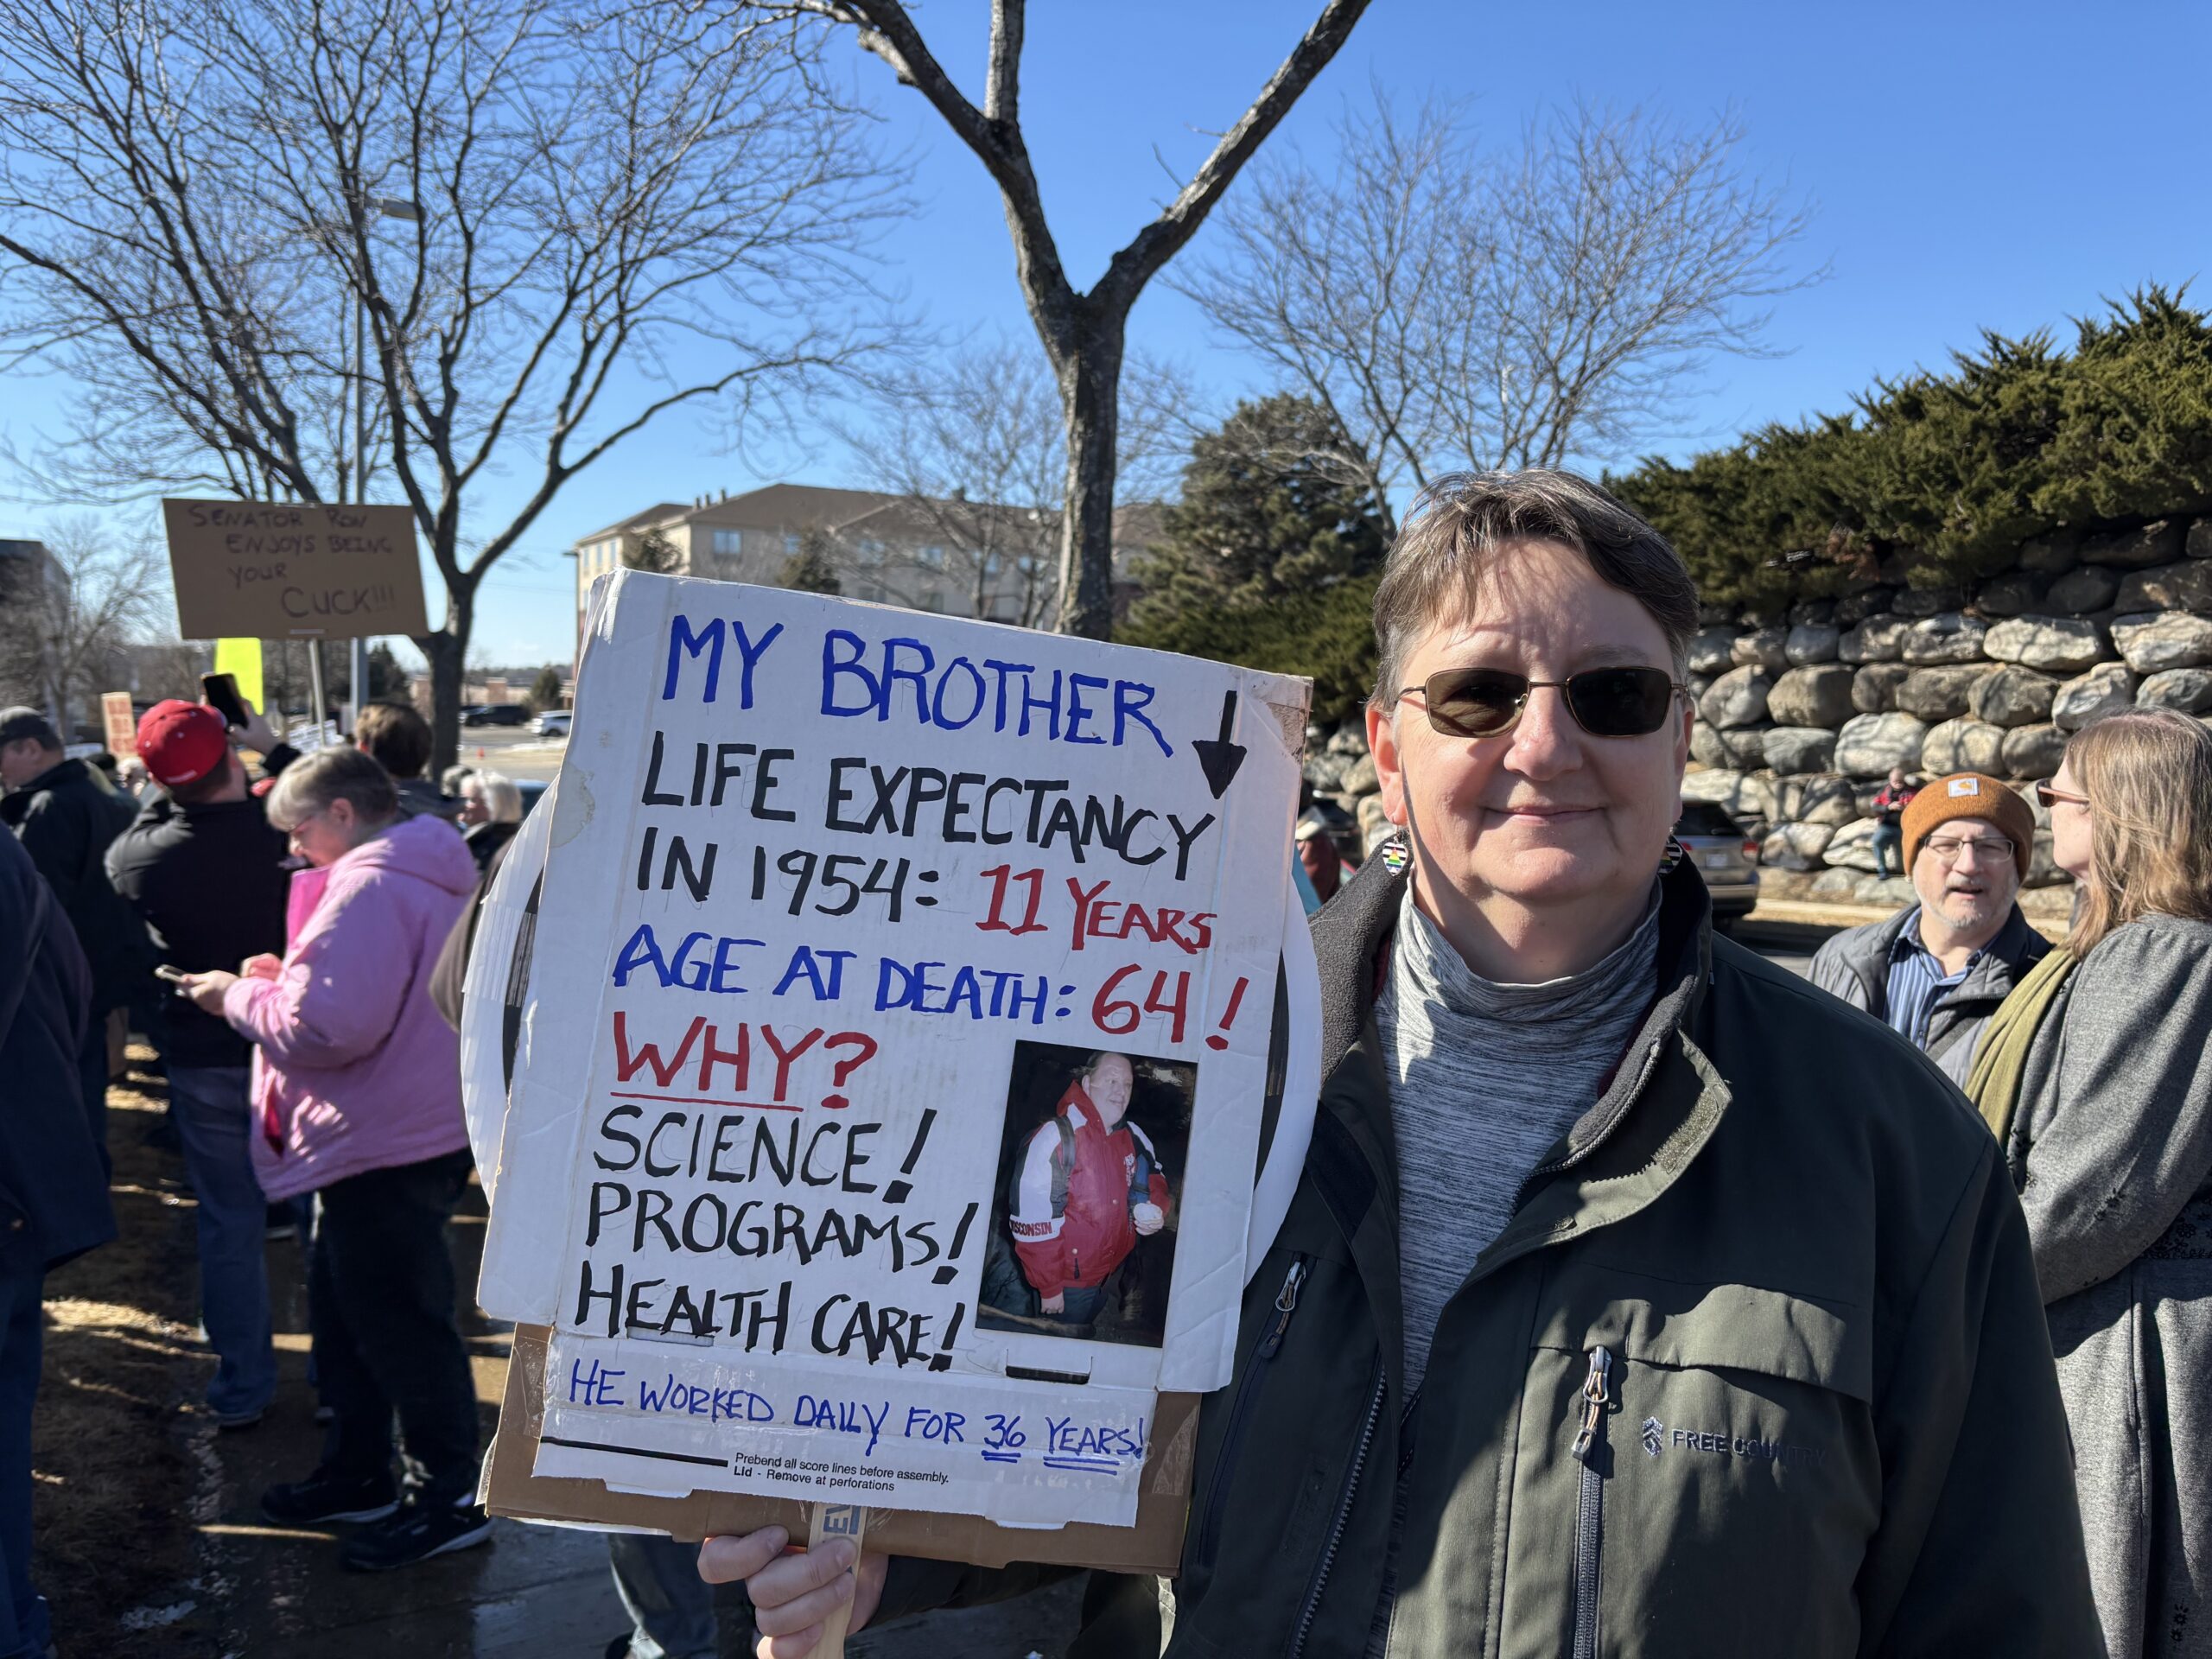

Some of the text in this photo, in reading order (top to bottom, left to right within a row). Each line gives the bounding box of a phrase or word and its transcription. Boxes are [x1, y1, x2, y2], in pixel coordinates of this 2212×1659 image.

[188, 504, 302, 528] SENATOR
[226, 533, 393, 556] ENJOYS BEING
[227, 563, 288, 589] YOUR
[280, 583, 396, 619] CUCK!!!
[662, 614, 1173, 758] MY BROTHER
[642, 731, 1215, 880] LIFE EXPECTANCY
[637, 827, 1217, 954] IN 1954: 11 YEARS
[613, 925, 766, 994] AGE
[772, 945, 856, 1000] AT
[874, 957, 1075, 1024] DEATH:
[613, 1011, 877, 1109] WHY?
[593, 1104, 937, 1204] SCIENCE!
[585, 1181, 979, 1285] PROGRAMS!
[575, 1261, 965, 1371] HEALTH CARE!
[569, 1358, 1145, 1459] HE WORKED DAILY FOR 36 YEARS!
[1672, 1428, 1727, 1452] FREE
[734, 1452, 949, 1485] Prebend all score lines before assembly.
[734, 1465, 753, 1478] Lid
[766, 1469, 811, 1484] Remove
[815, 1474, 827, 1485] at
[830, 1477, 895, 1491] perforations
